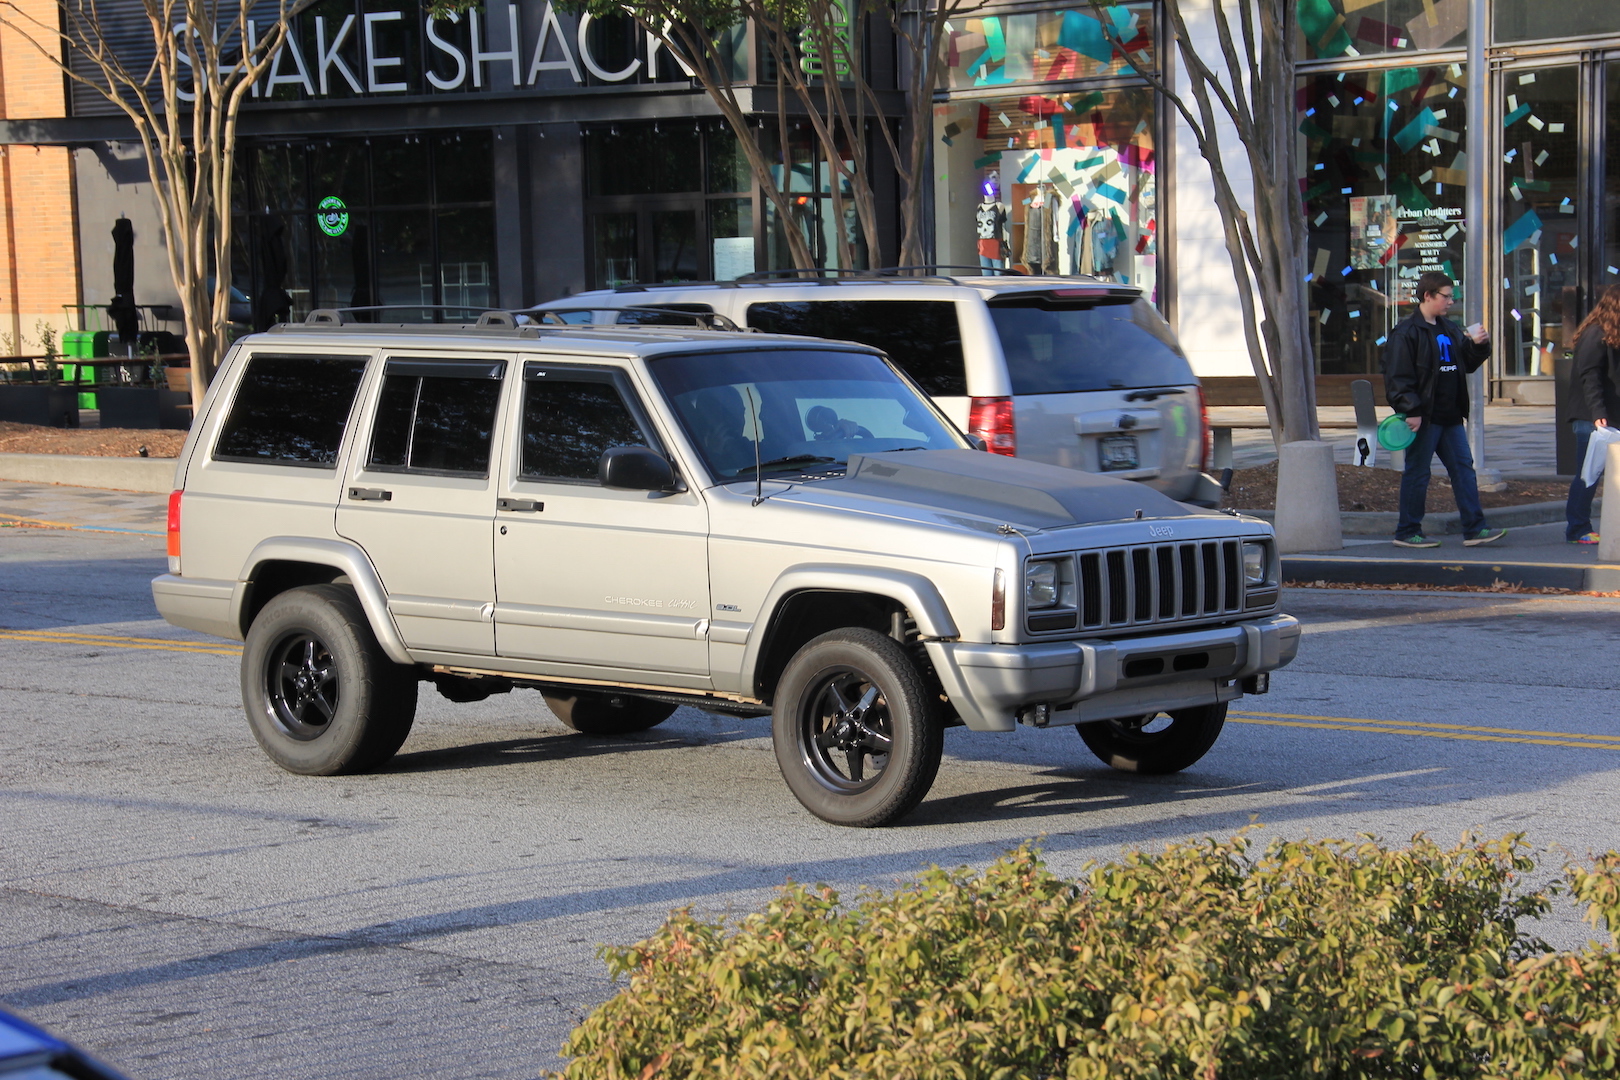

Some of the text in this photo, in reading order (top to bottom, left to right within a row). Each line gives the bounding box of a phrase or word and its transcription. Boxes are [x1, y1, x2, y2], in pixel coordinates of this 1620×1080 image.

[173, 0, 697, 101] SHAKE SHACK
[1397, 206, 1462, 218] Urban Outfitters
[1149, 525, 1174, 537] Jeep
[604, 595, 663, 608] CHEROKEE
